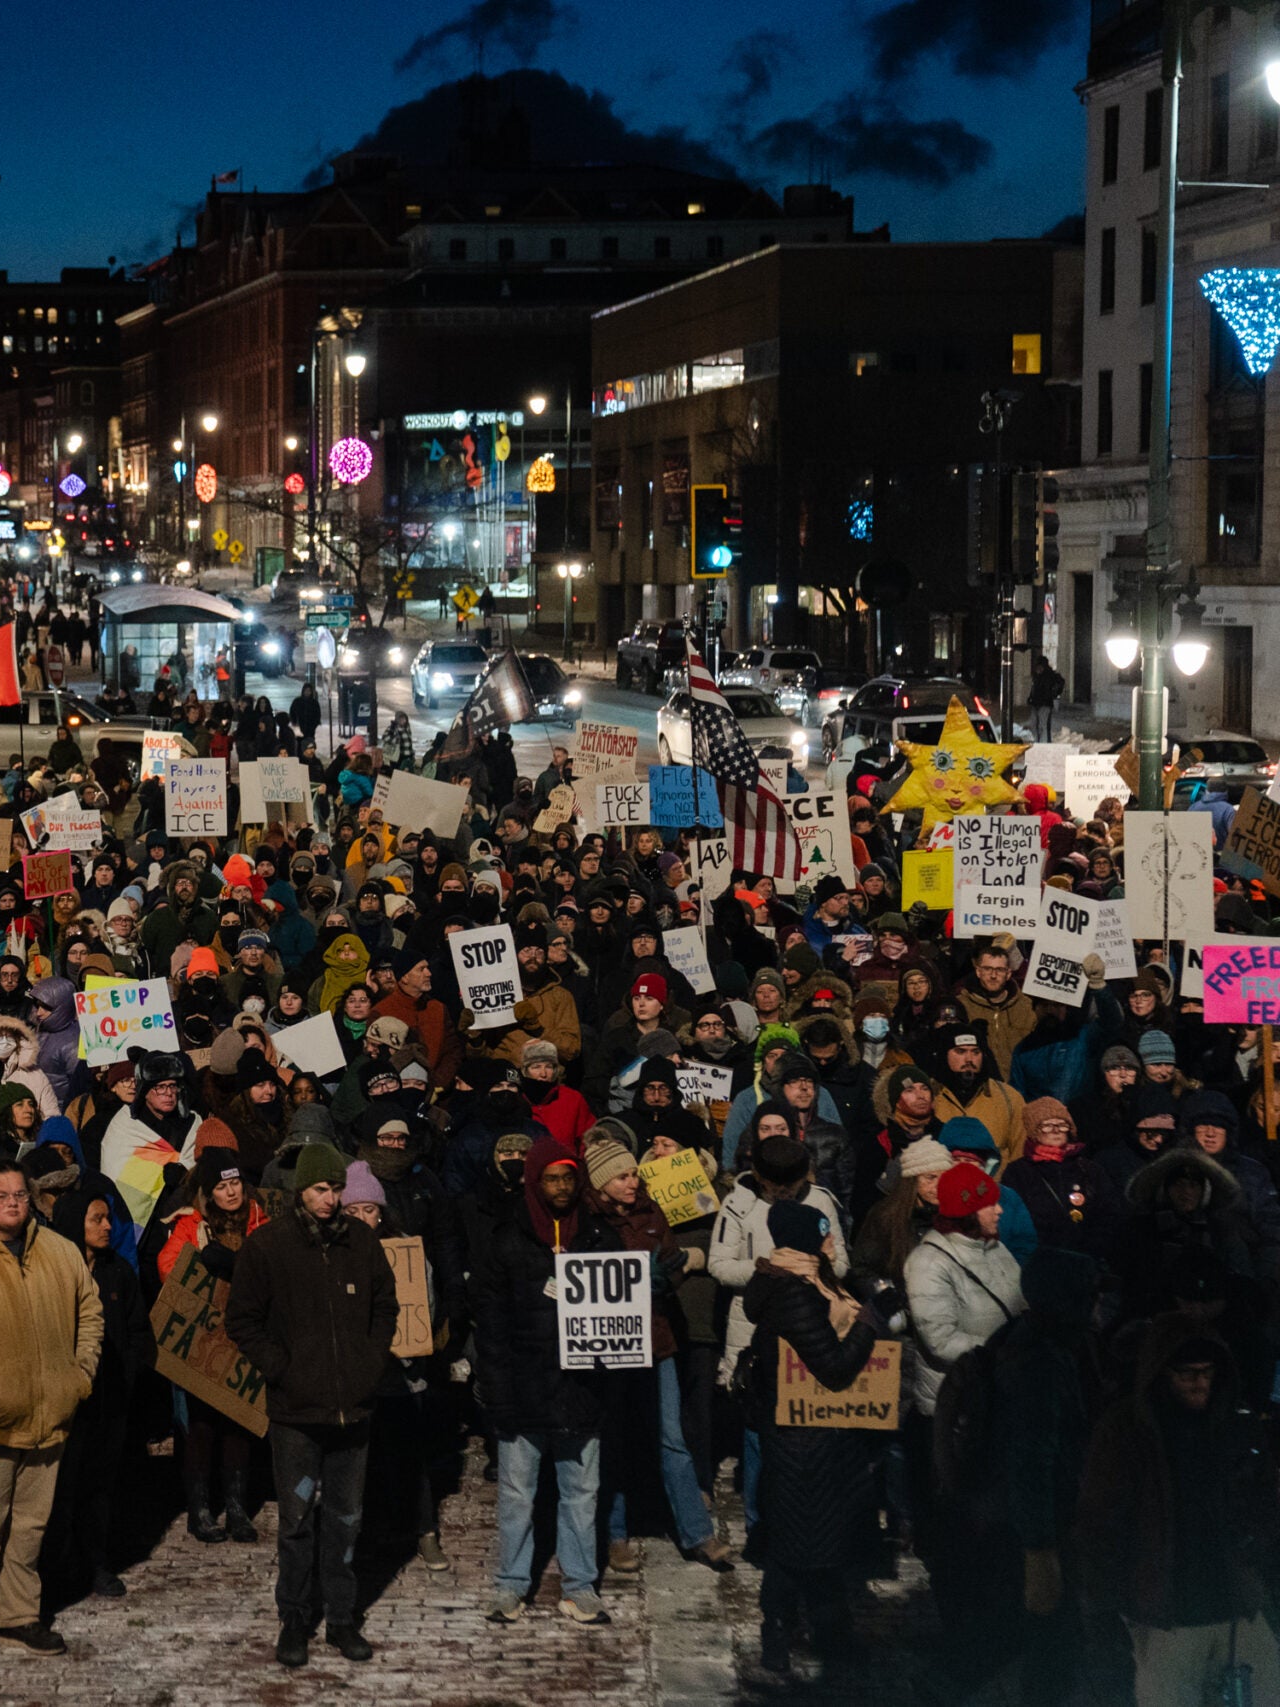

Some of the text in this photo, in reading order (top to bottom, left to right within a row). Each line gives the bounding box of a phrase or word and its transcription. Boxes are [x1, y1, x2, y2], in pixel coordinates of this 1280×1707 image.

[581, 722, 619, 734] RESIST
[149, 748, 169, 760] ICE
[170, 765, 193, 777] Pond
[261, 764, 288, 777] WAKE
[171, 781, 217, 796] Players
[272, 777, 285, 788] UP
[263, 787, 302, 801] CONGRESS
[605, 786, 643, 802] FUCK
[172, 794, 224, 815] Against
[602, 801, 640, 823] ICE
[1256, 796, 1280, 822] EN
[49, 821, 101, 832] DUE PROCESS
[958, 817, 1040, 837] NO Human
[959, 837, 972, 850] is
[980, 835, 1032, 853] Illegal
[1232, 828, 1280, 879] TERRO
[32, 858, 51, 869] ICE
[961, 850, 1039, 867] on Stolen
[28, 867, 62, 881] OUT OF
[982, 866, 1026, 887] Land
[27, 877, 69, 897] MY CITY
[977, 893, 1025, 908] fargin
[963, 913, 1037, 928] ICEholes
[1046, 900, 1090, 936] STOP
[461, 938, 507, 969] STOP
[1039, 952, 1084, 976] DEPORTING
[1205, 946, 1280, 996] FREED
[1036, 967, 1080, 990] OUR
[1241, 976, 1280, 1000] FRO
[468, 980, 514, 998] DEPORTING
[75, 987, 149, 1015] RISE UP
[471, 993, 516, 1010] OUR
[1248, 1001, 1280, 1024] FEA
[100, 1012, 174, 1037] Queens
[677, 1076, 703, 1090] OUR
[639, 1153, 693, 1180] ALL ARE
[652, 1174, 708, 1204] ELCOME
[667, 1203, 699, 1225] ERE
[565, 1258, 642, 1304] STOP
[566, 1315, 643, 1337] ICE TERROR
[566, 1337, 644, 1352] NOW!
[788, 1398, 892, 1425] Hierarchy
